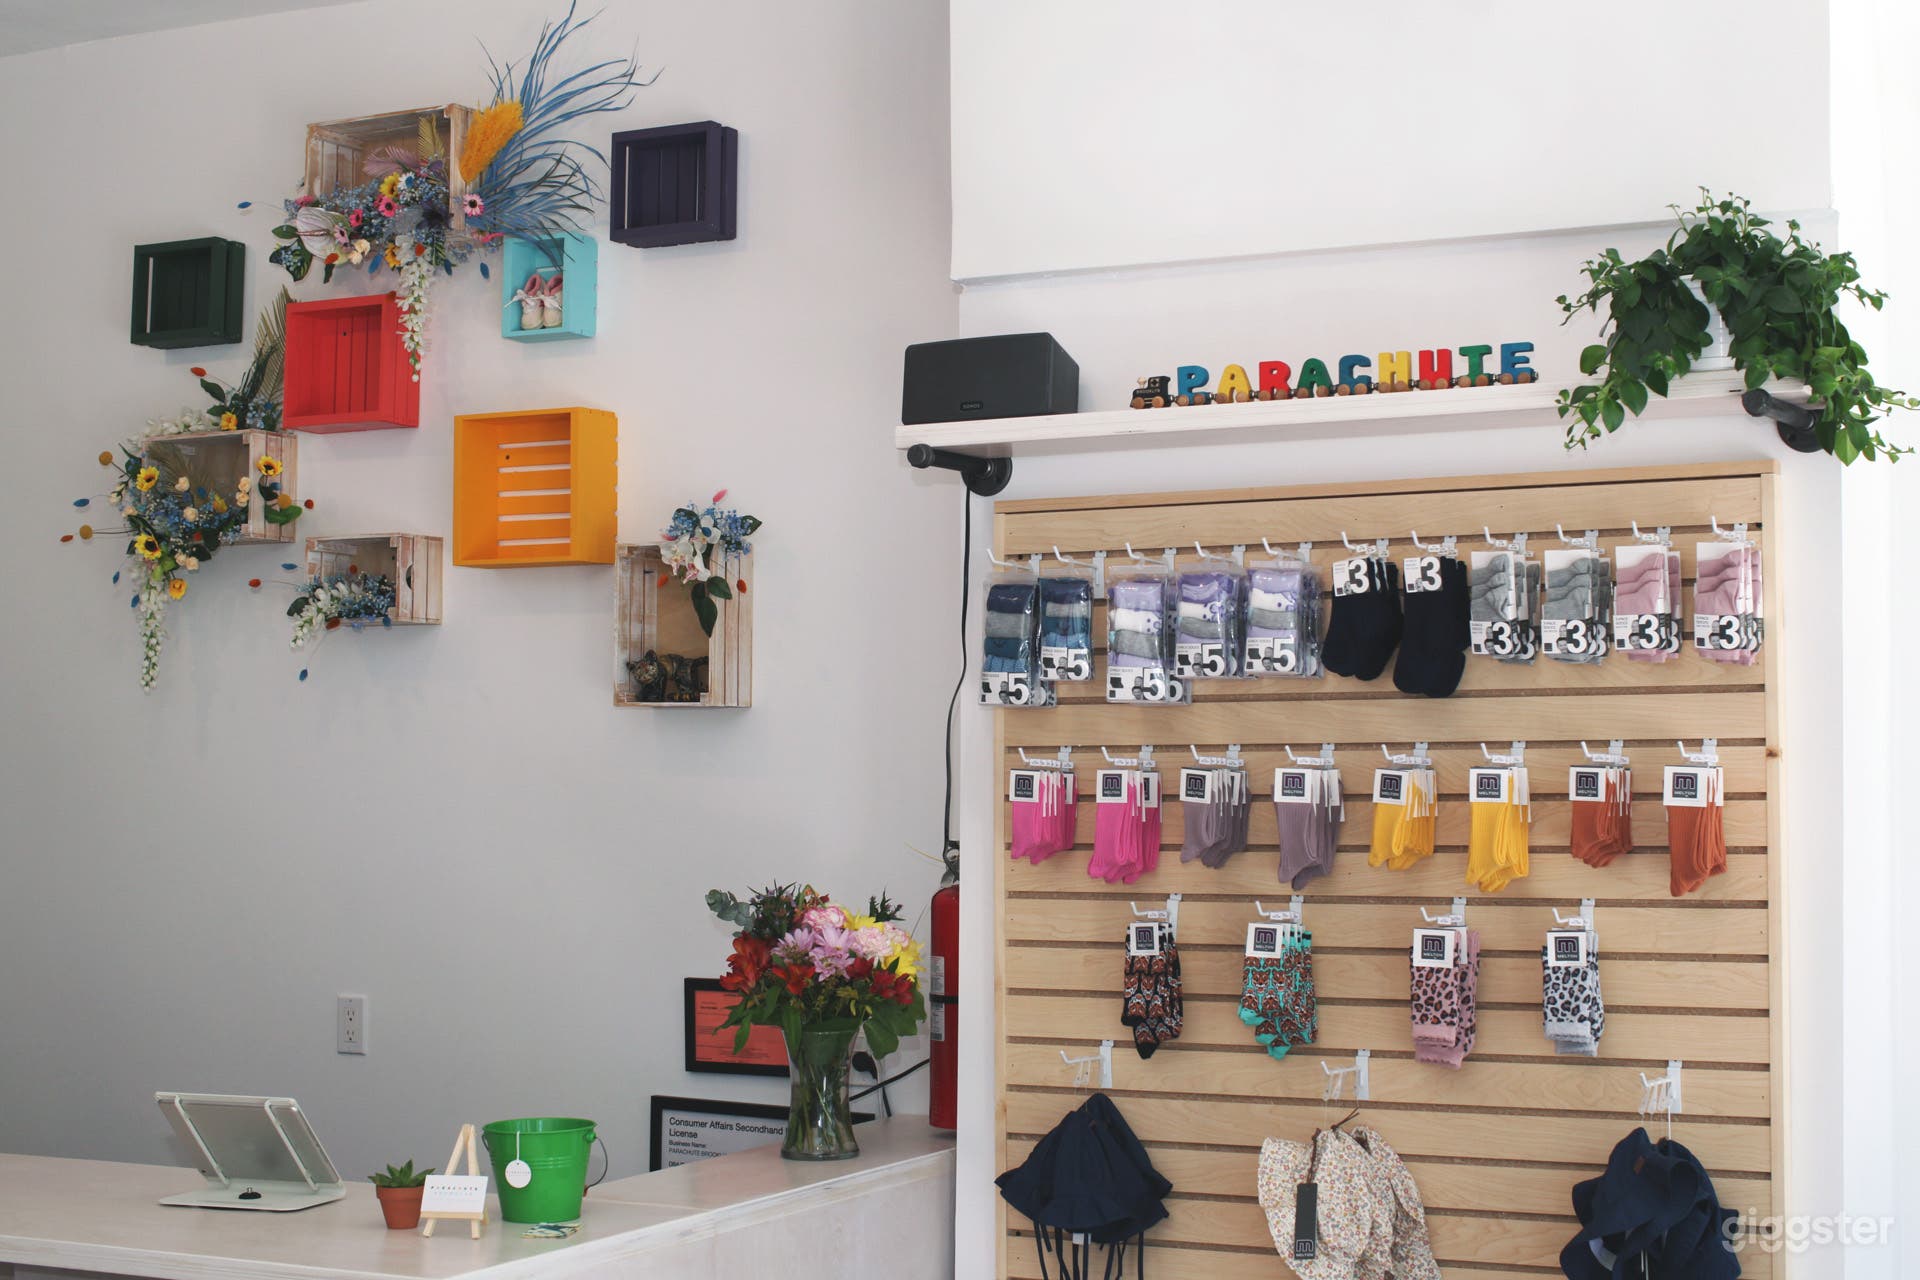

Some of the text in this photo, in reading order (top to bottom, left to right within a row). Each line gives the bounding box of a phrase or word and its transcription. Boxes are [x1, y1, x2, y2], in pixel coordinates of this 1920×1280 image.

[1176, 341, 1535, 404] PARACHUTE
[1349, 559, 1370, 594] 3
[1420, 556, 1442, 591] 3
[1492, 621, 1513, 655] 3
[1566, 619, 1587, 654] 3
[1638, 614, 1660, 649] 3
[1719, 615, 1741, 650] 3
[1067, 648, 1090, 681] 5
[1202, 643, 1225, 677] 5
[1273, 638, 1296, 673] 5
[1008, 672, 1030, 705] 5
[1143, 667, 1165, 702] 5
[669, 1116, 708, 1128] Consumer
[709, 1120, 733, 1131] Affairs
[735, 1122, 783, 1136] Secondhand
[669, 1128, 698, 1139] License
